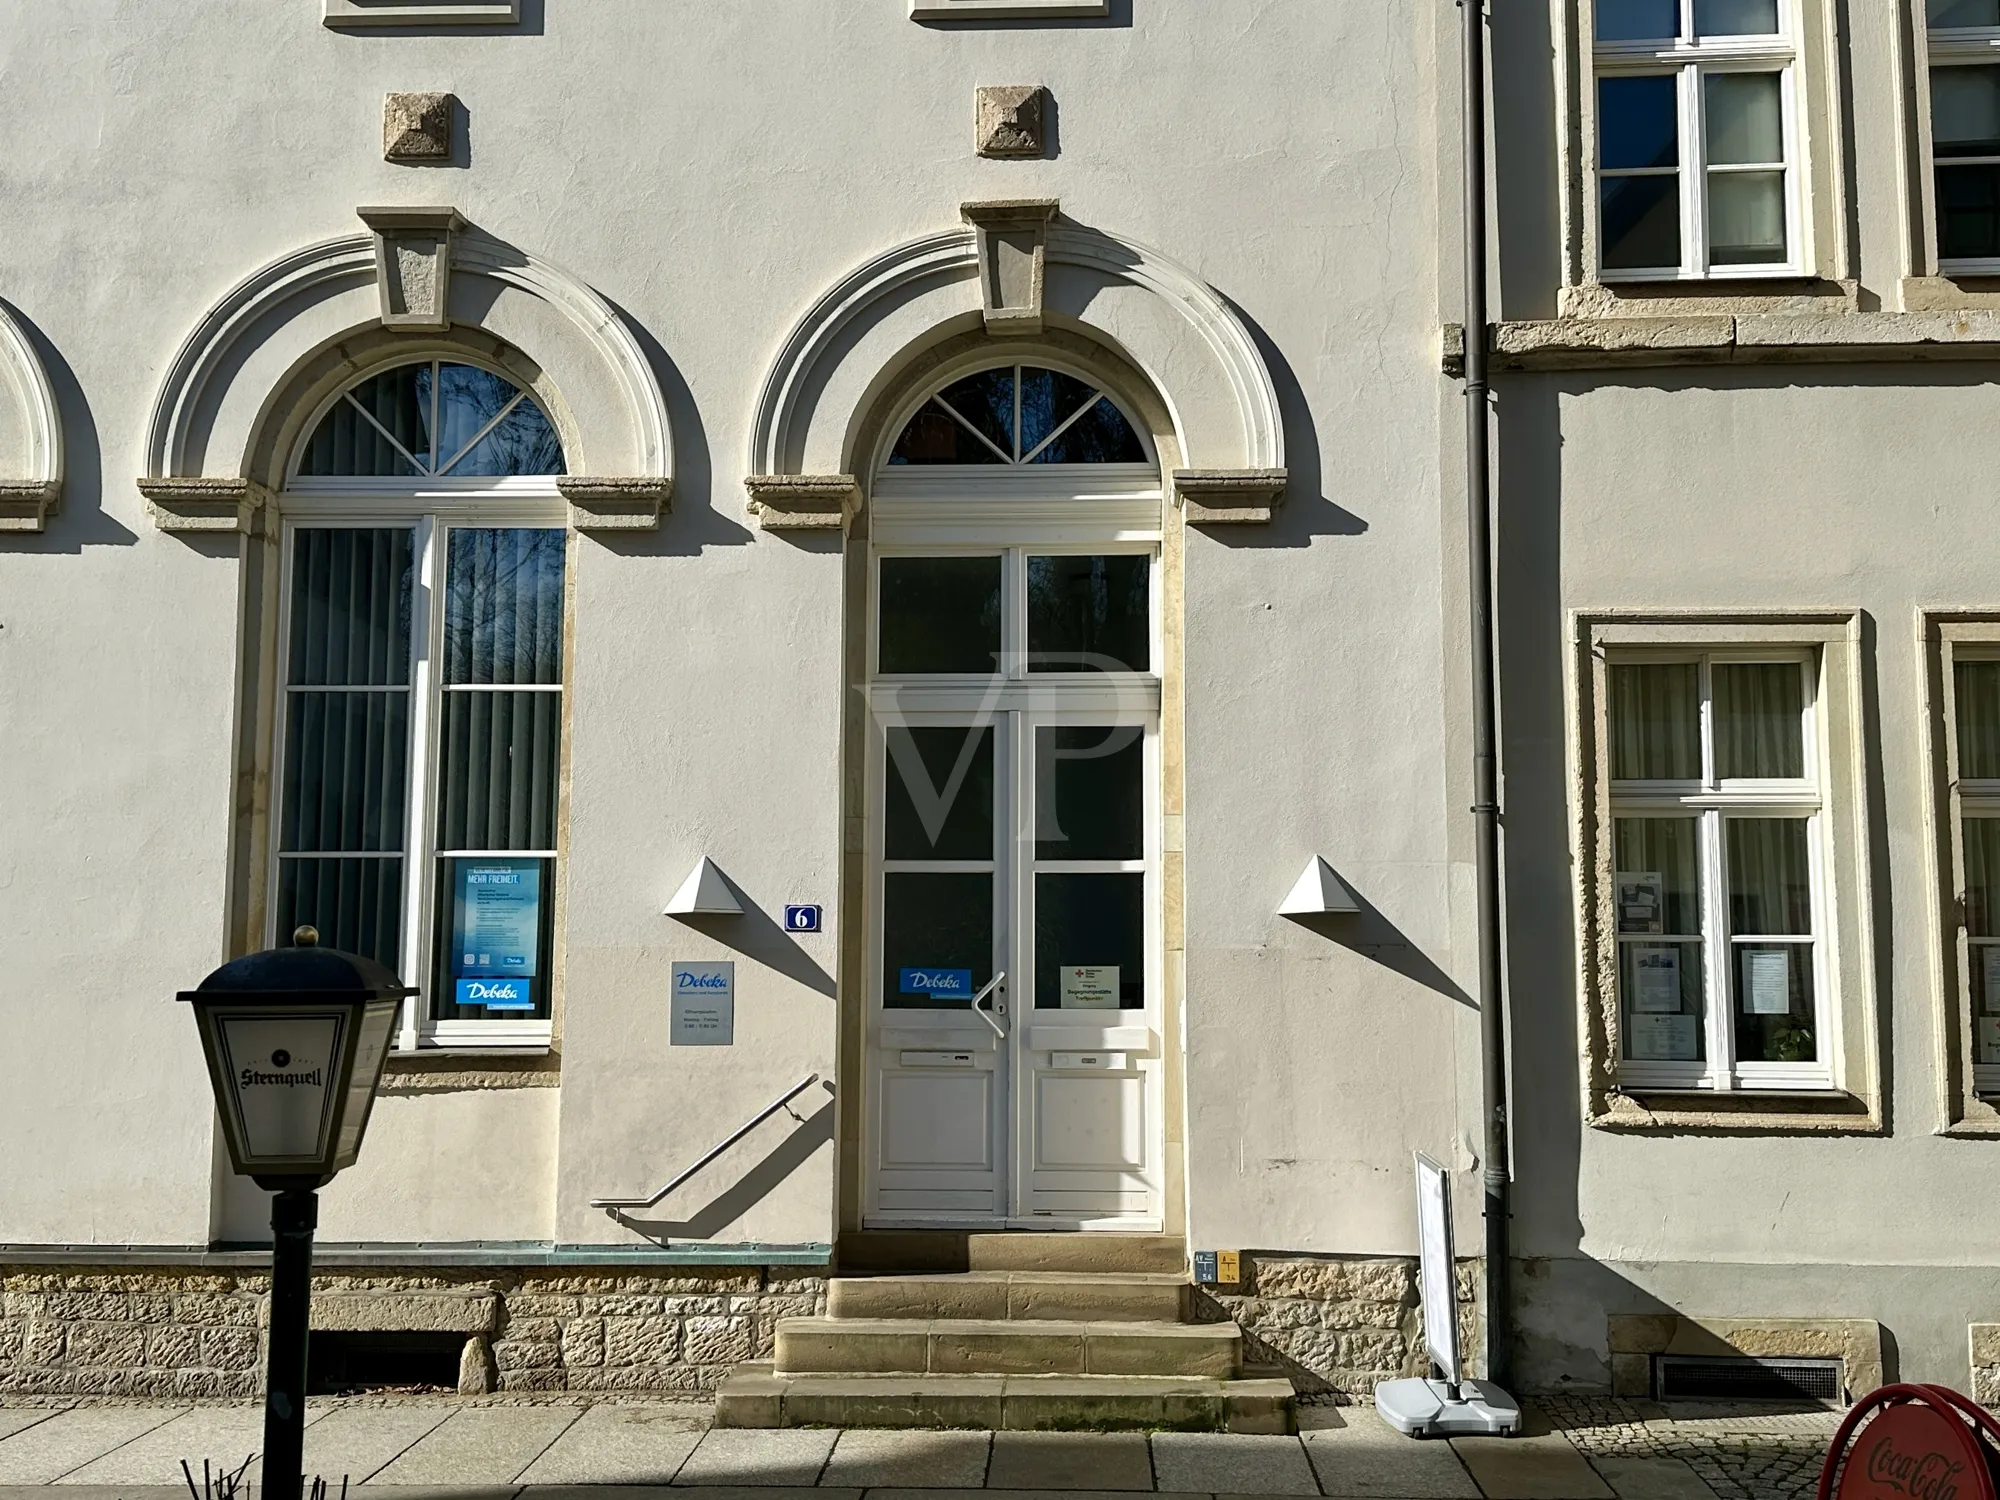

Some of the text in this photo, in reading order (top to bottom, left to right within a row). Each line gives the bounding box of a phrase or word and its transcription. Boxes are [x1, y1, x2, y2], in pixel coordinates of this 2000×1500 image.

[467, 874, 487, 884] MEHR
[795, 908, 808, 927] 6
[676, 972, 728, 989] Debeka
[909, 971, 961, 989] Debeka
[466, 982, 518, 999] Debeka
[241, 1068, 322, 1090] Sternquell
